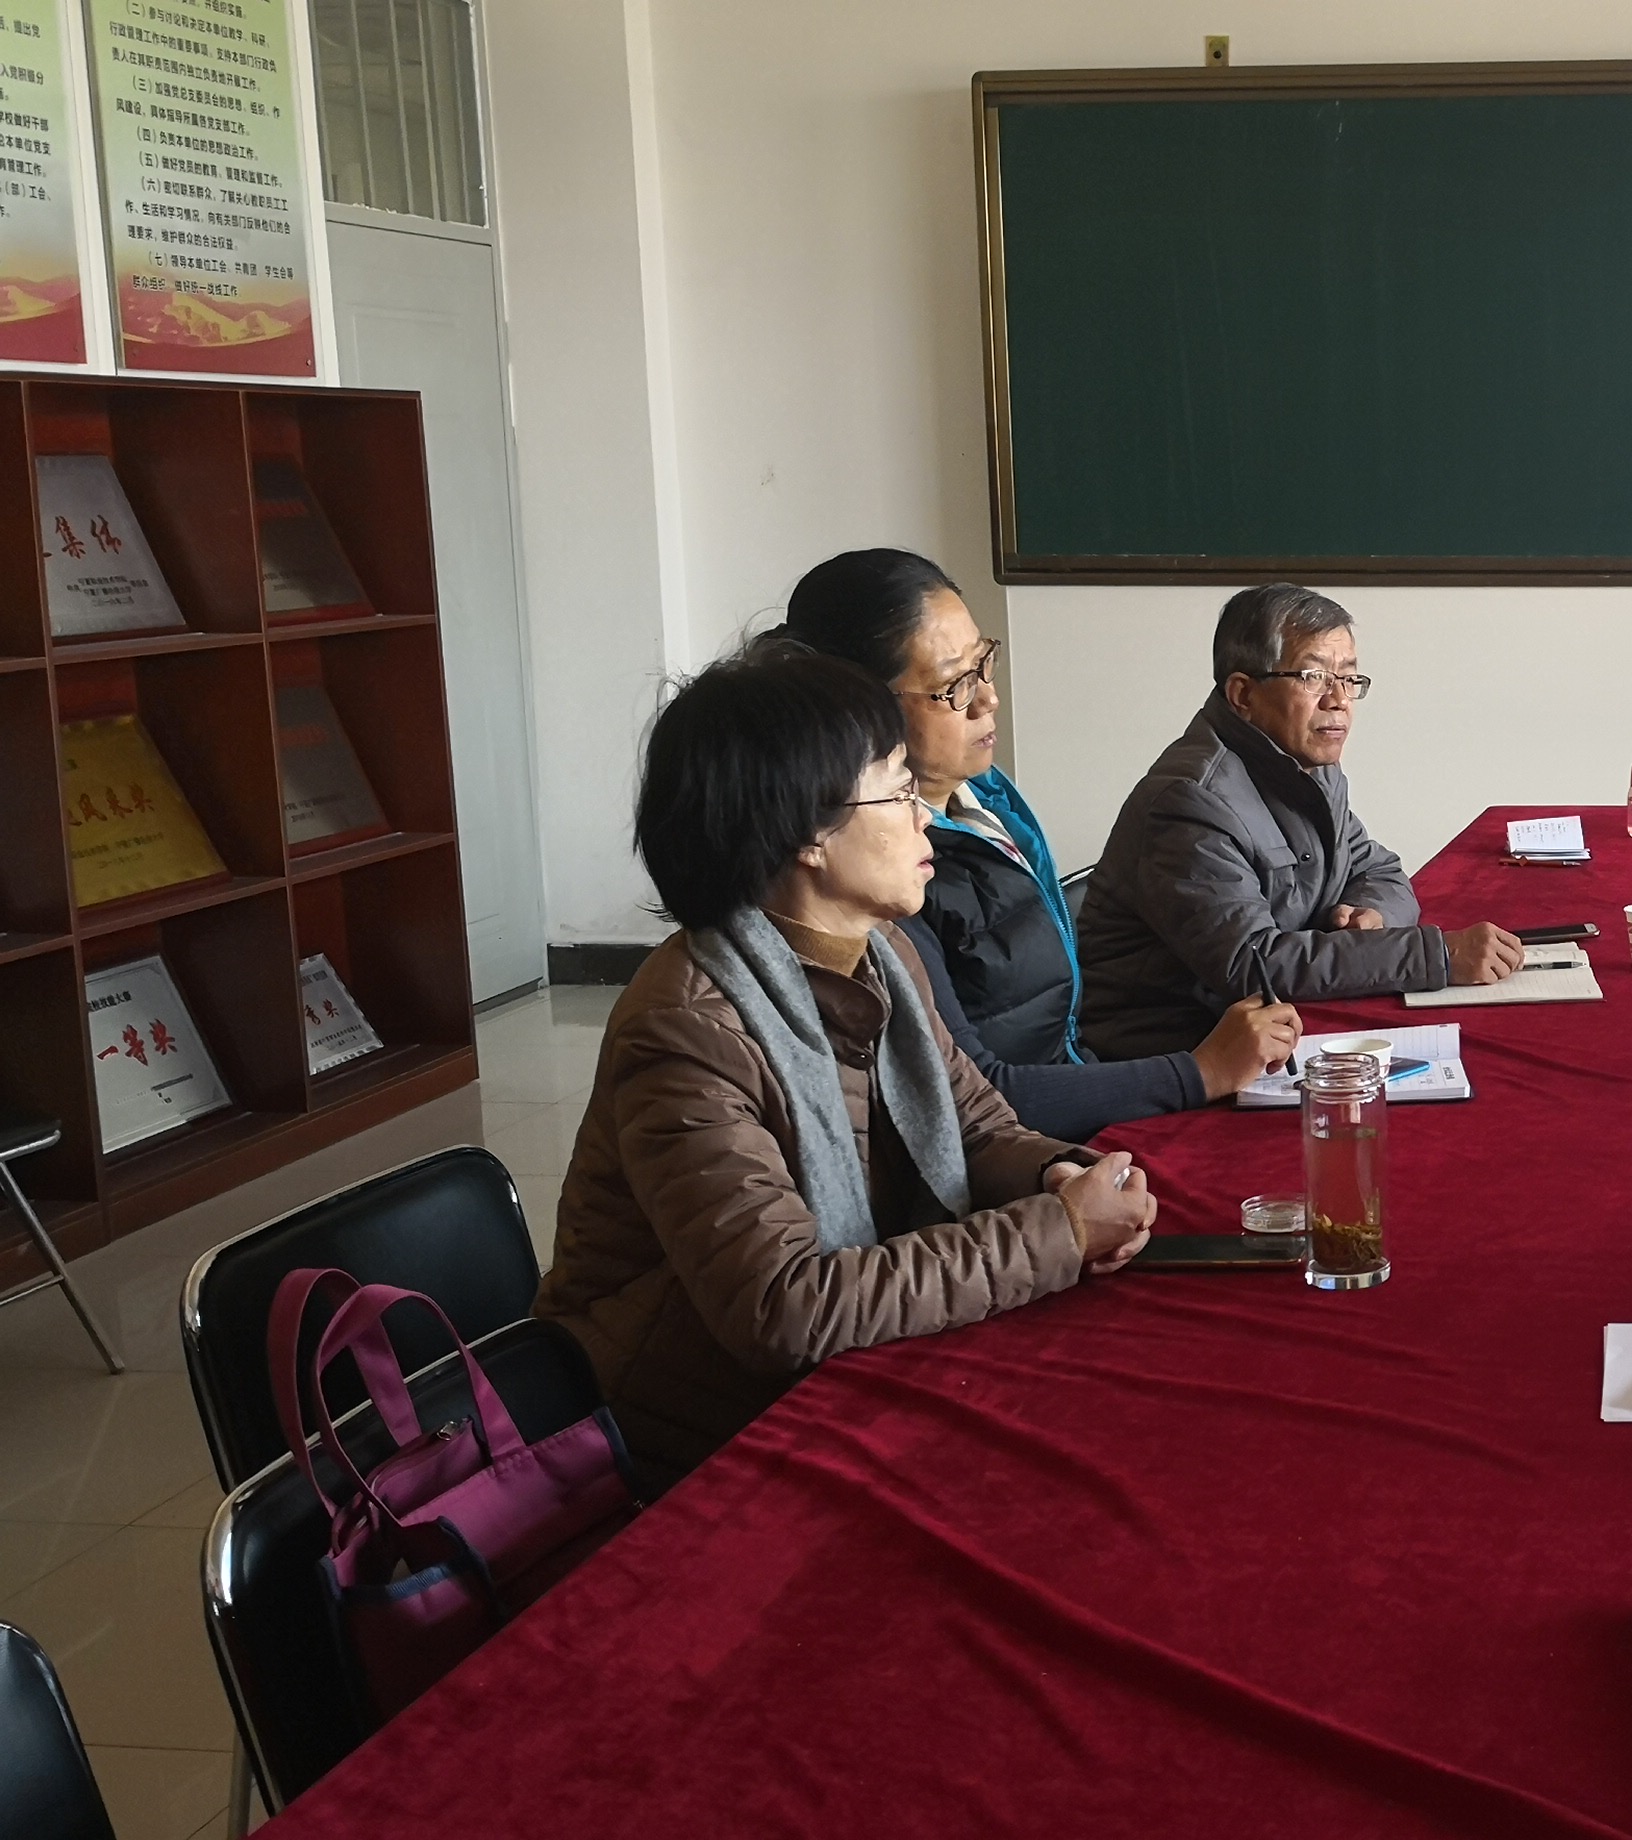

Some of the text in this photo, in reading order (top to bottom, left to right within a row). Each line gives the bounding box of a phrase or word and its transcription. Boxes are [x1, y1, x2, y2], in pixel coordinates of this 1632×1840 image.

[136, 125, 259, 161] （四）负责本单位的思想政治工作。
[43, 514, 122, 559] 集体
[97, 1019, 178, 1066] 一等奖
